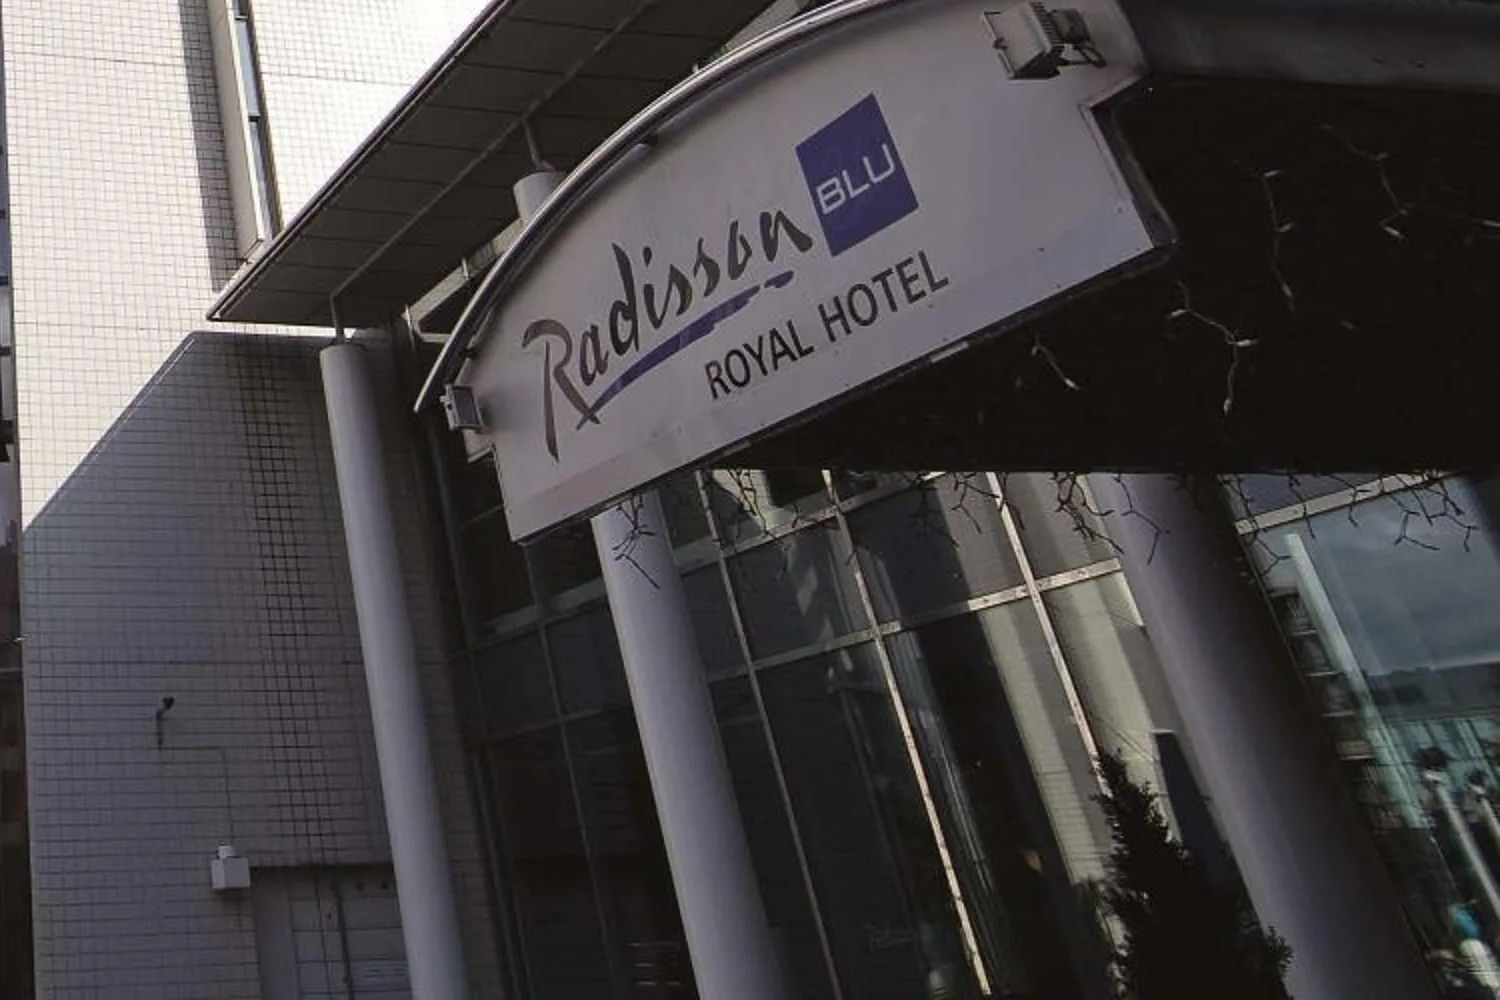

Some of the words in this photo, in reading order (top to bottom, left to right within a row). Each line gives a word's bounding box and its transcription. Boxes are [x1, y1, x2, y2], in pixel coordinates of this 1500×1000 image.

[521, 204, 814, 463] Radisson
[816, 143, 896, 215] BLU
[704, 319, 815, 400] ROYAL
[818, 249, 950, 343] HOTEL
